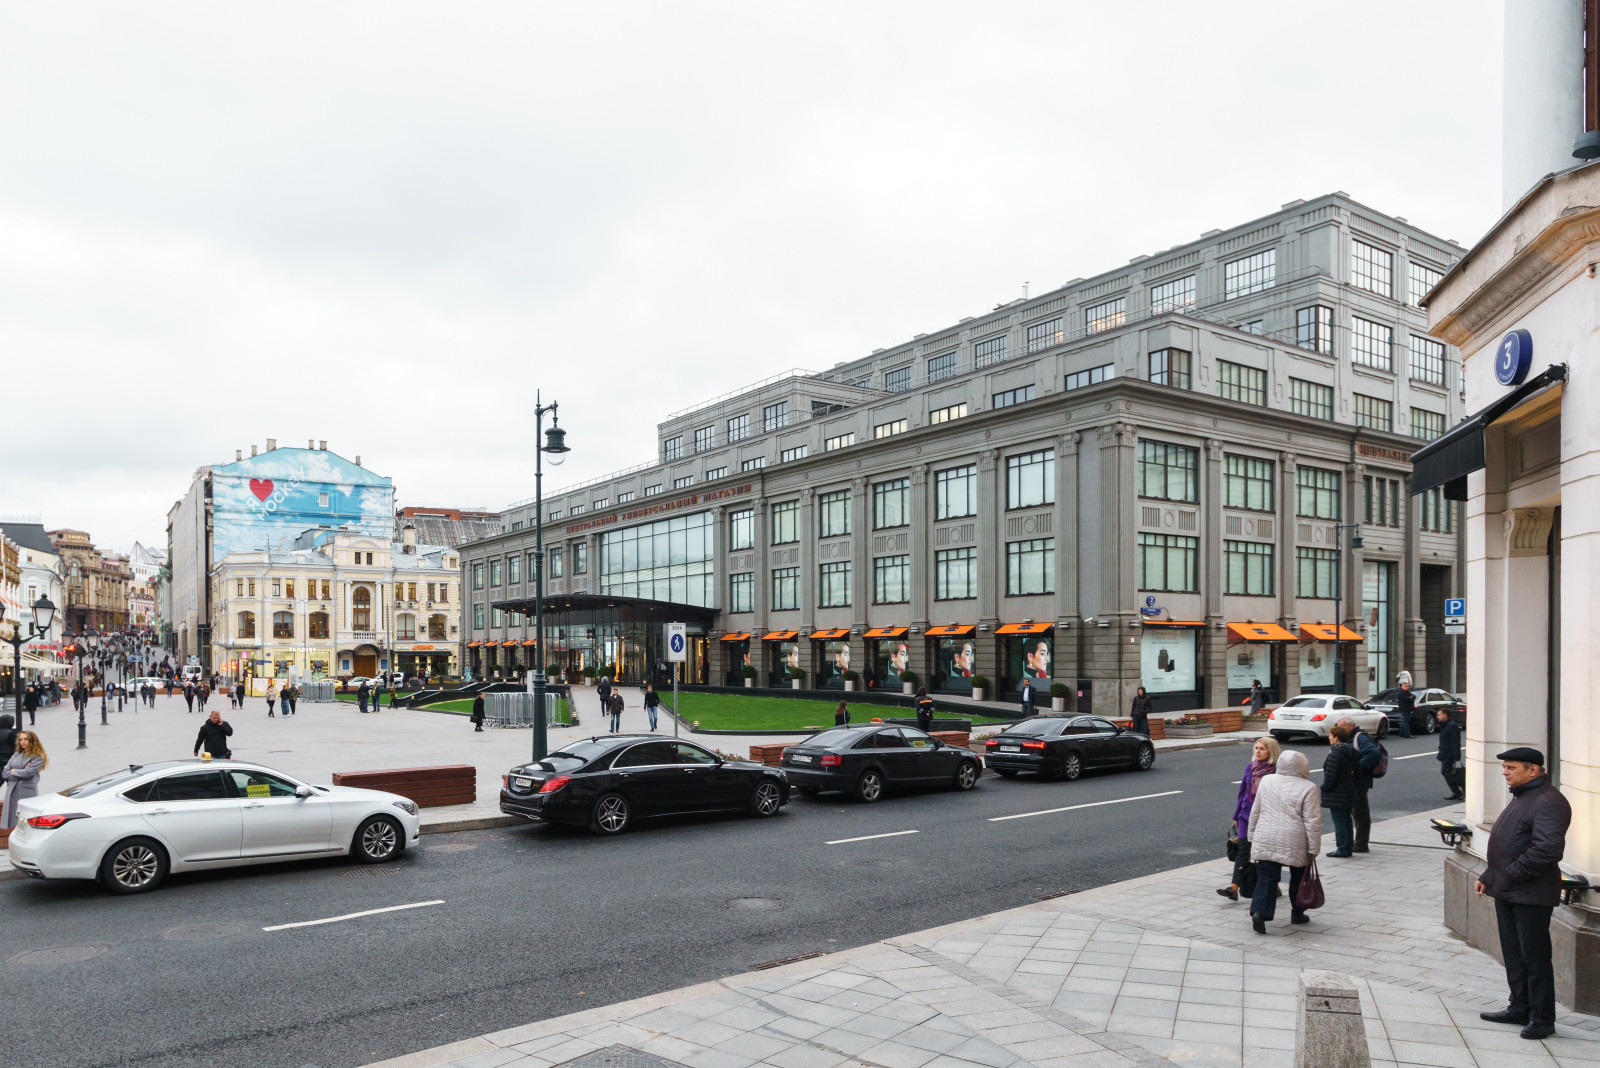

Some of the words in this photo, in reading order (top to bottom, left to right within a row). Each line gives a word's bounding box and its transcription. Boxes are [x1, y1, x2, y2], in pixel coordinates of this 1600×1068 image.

[1503, 340, 1512, 370] 3
[257, 465, 305, 521] МОСКВУ
[622, 493, 699, 521] УНИВЕРСАЛЬНЫЙ
[703, 483, 753, 503] МАГАЗИН
[1450, 601, 1462, 615] P
